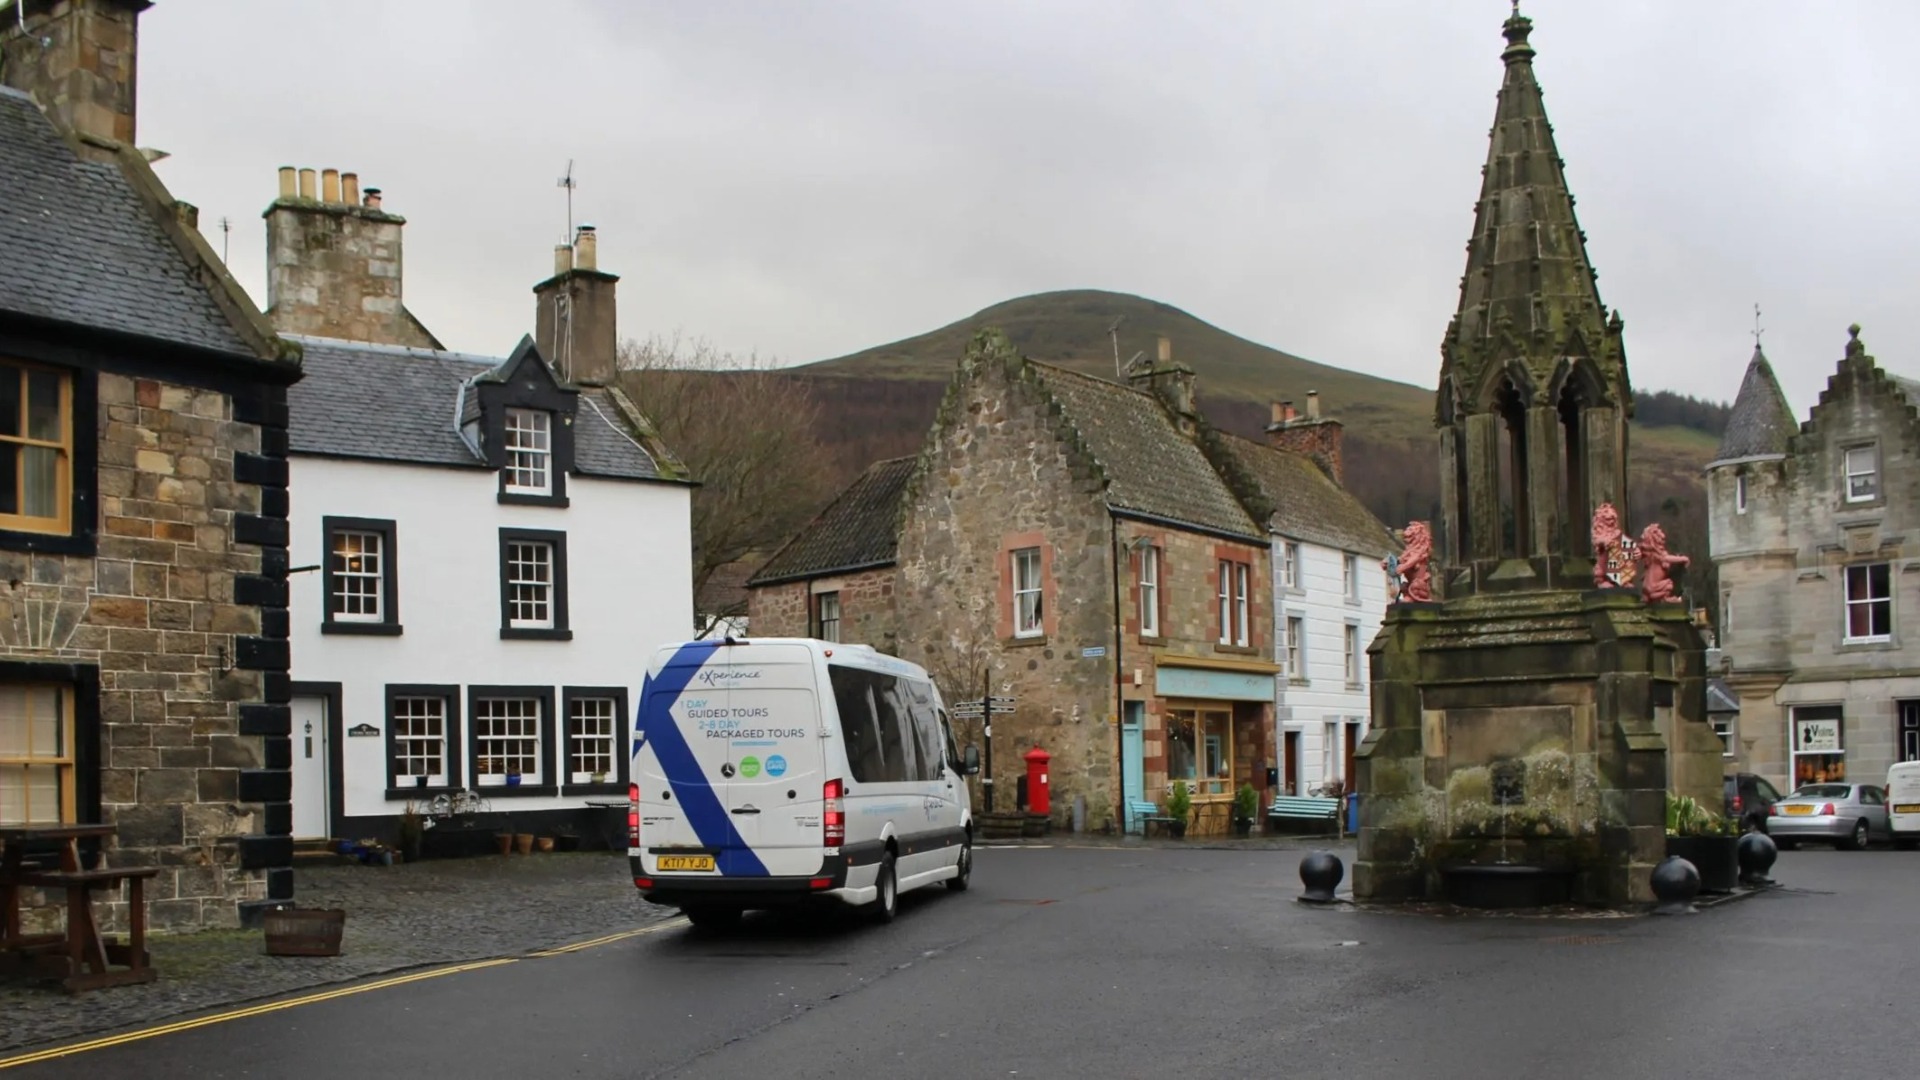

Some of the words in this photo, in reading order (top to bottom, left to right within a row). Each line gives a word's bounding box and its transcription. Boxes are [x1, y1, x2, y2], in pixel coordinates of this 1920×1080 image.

[687, 700, 708, 709] DAY
[688, 709, 729, 718] GUIDED
[732, 708, 769, 718] TOURS
[718, 720, 740, 730] DAY
[706, 729, 764, 739] PACKAGED
[767, 729, 805, 738] TOURS
[663, 858, 686, 868] KT17
